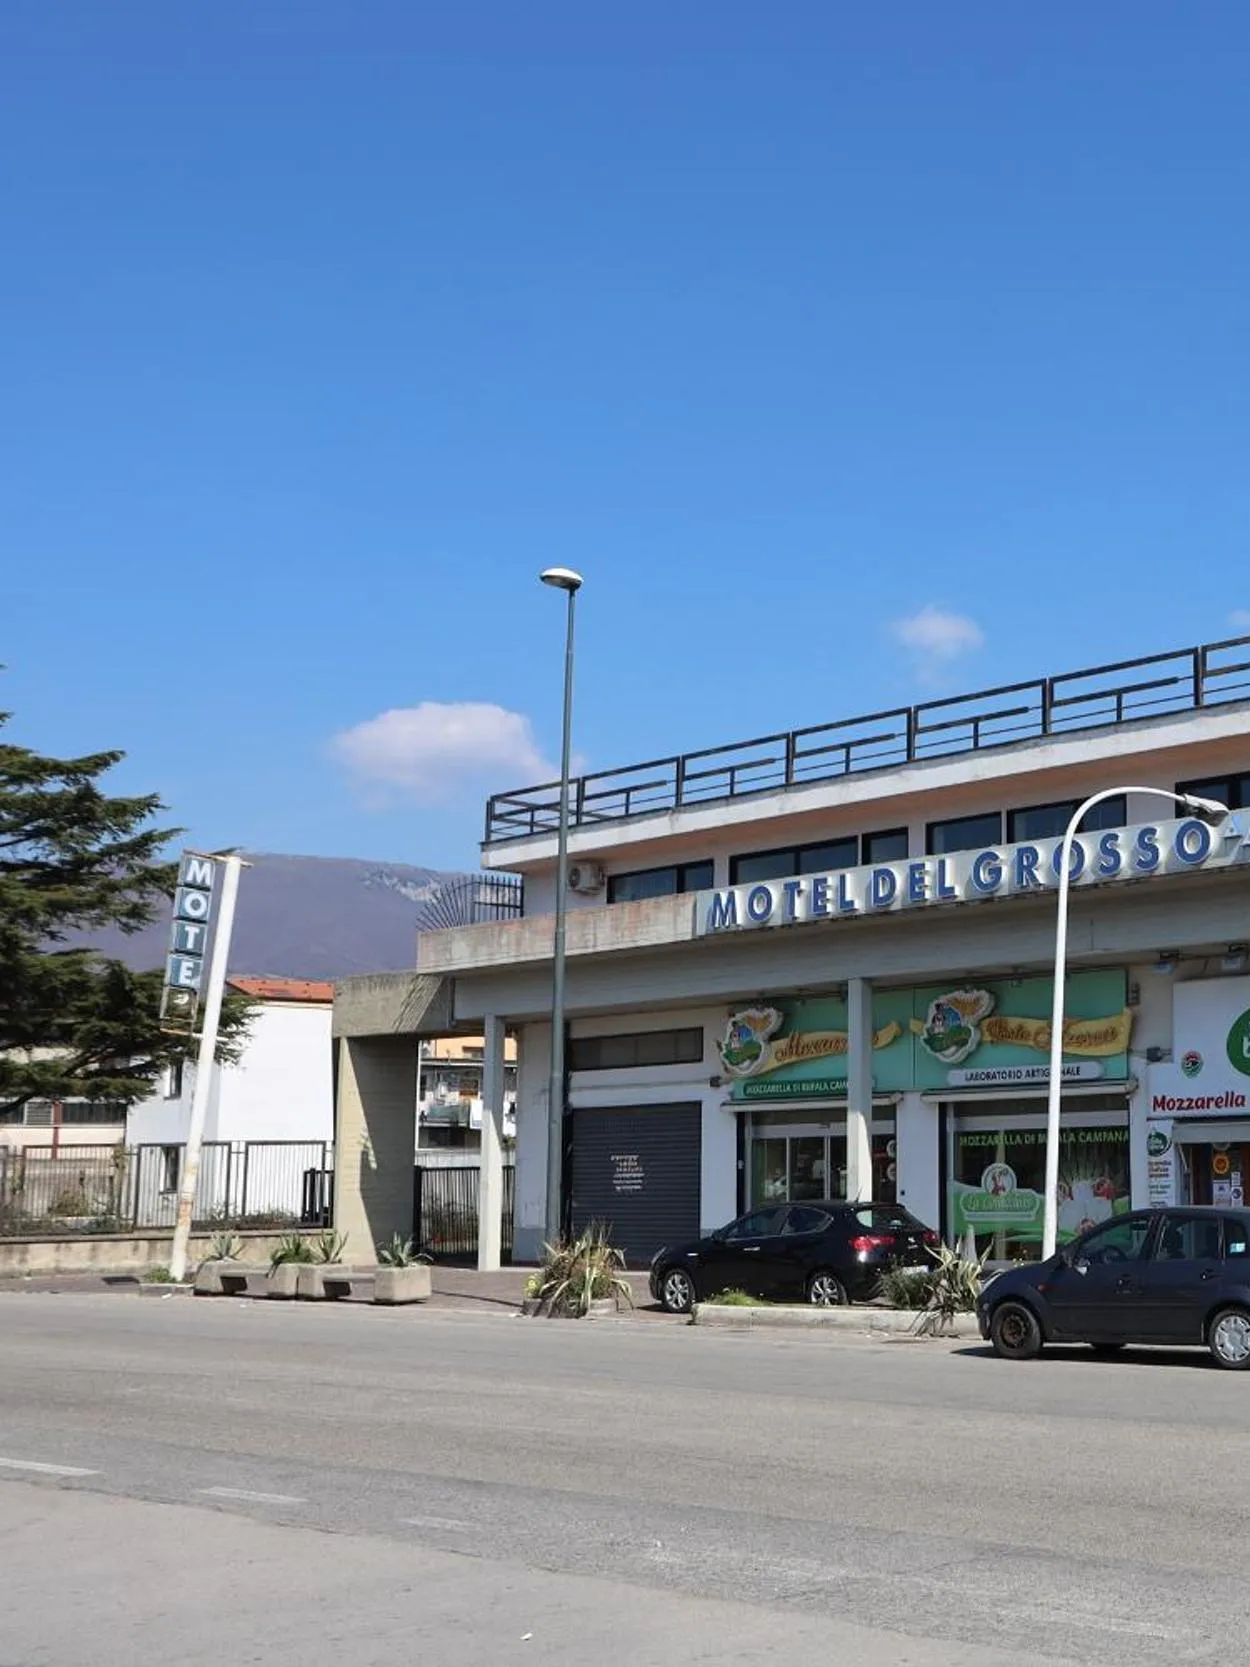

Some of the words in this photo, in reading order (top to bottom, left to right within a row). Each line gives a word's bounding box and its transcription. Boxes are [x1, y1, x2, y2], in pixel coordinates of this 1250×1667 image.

[711, 873, 855, 929] MOTEL
[871, 859, 957, 907] DEL
[972, 820, 1211, 892] GROSSO
[964, 1068, 1022, 1081] LABORATORIO
[1152, 1091, 1245, 1112] Mozzarella
